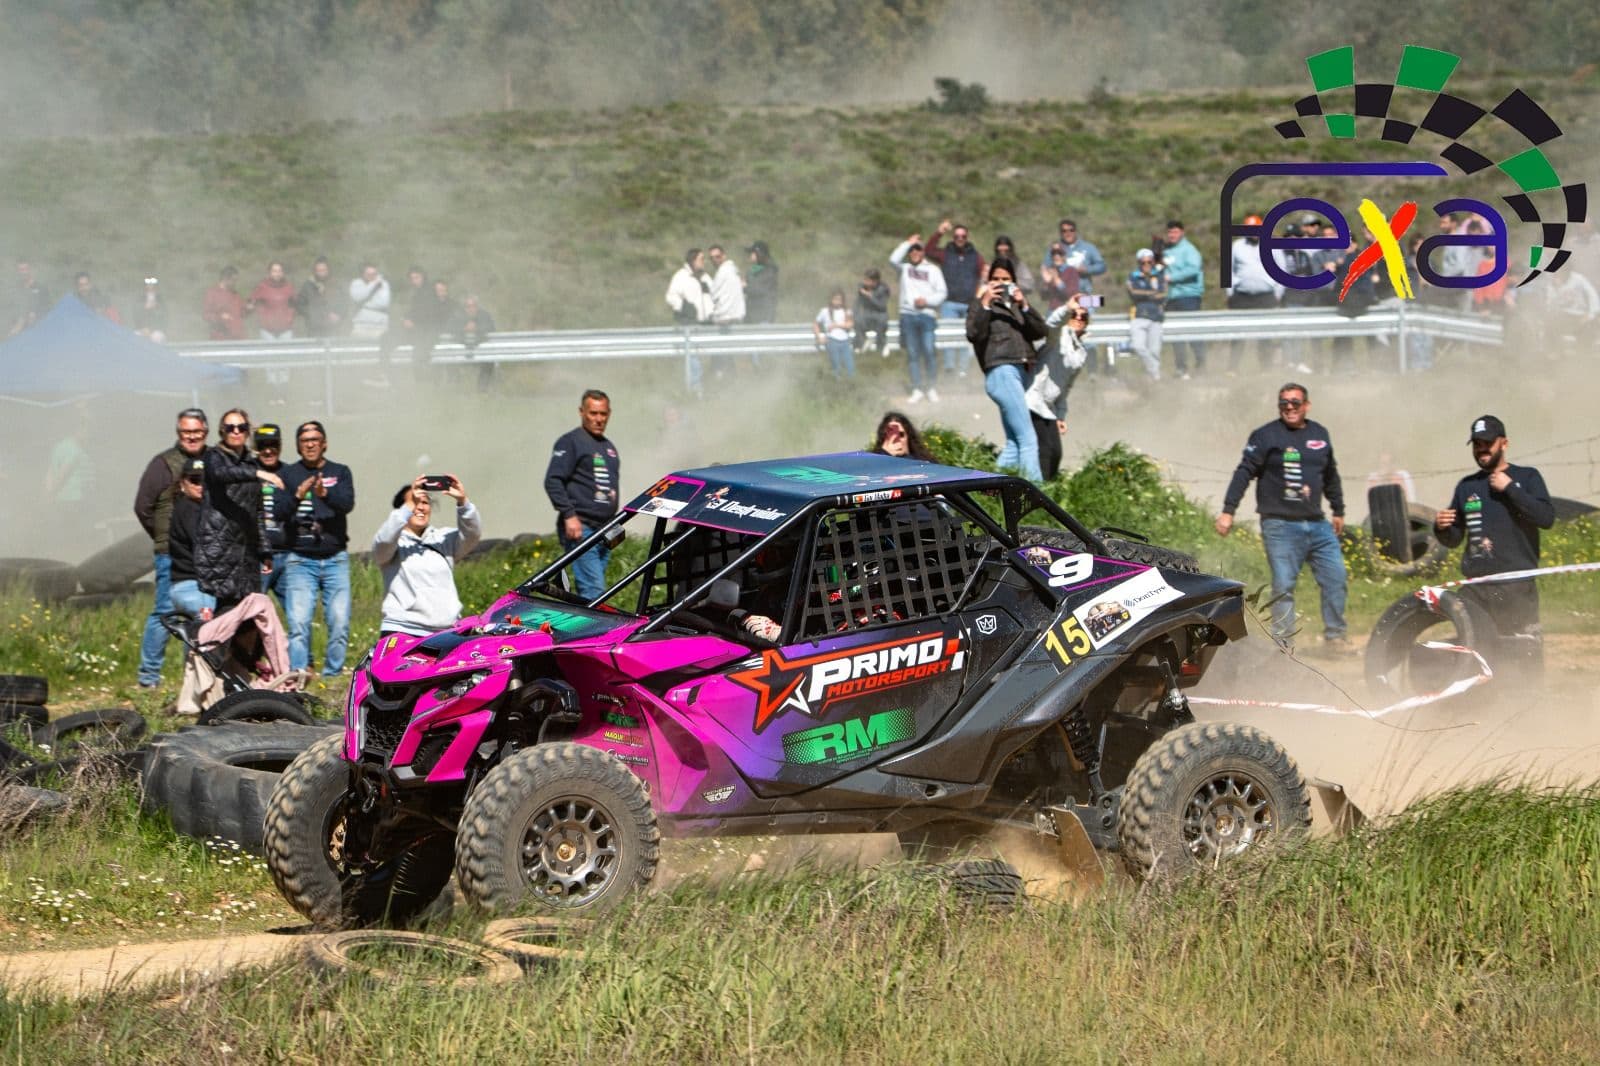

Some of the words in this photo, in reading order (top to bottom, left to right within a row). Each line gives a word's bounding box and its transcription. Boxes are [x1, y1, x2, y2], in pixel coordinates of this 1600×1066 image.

[1048, 553, 1094, 587] 9
[1045, 616, 1091, 665] 15
[808, 637, 944, 703] PRIMO
[826, 659, 950, 699] MOTORSPORT
[784, 708, 906, 763] RM
